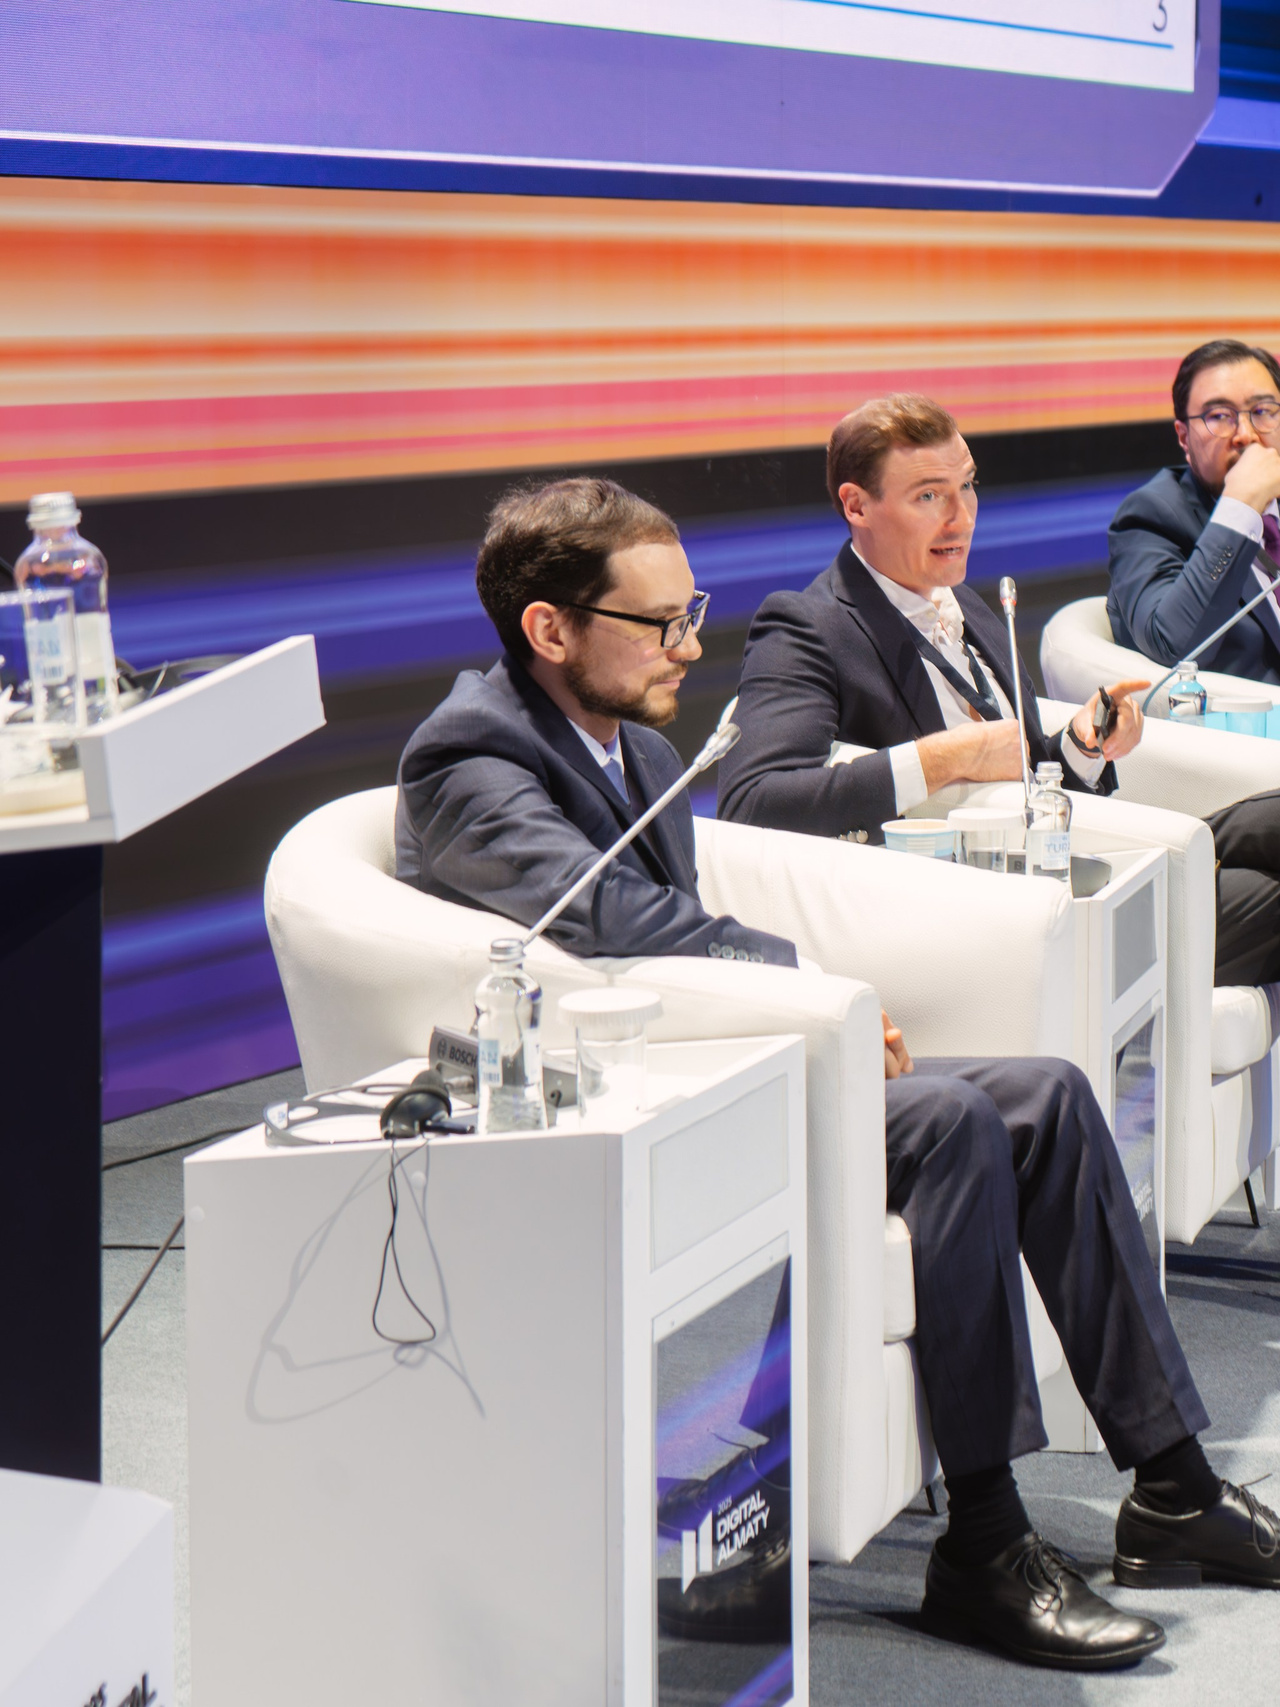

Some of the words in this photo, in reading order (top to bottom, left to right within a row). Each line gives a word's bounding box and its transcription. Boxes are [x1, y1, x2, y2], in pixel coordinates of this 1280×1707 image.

[449, 1045, 478, 1069] BOSCH
[716, 1489, 766, 1542] DIGITAL
[717, 1495, 733, 1516] 2025
[717, 1506, 770, 1567] ALMATY
